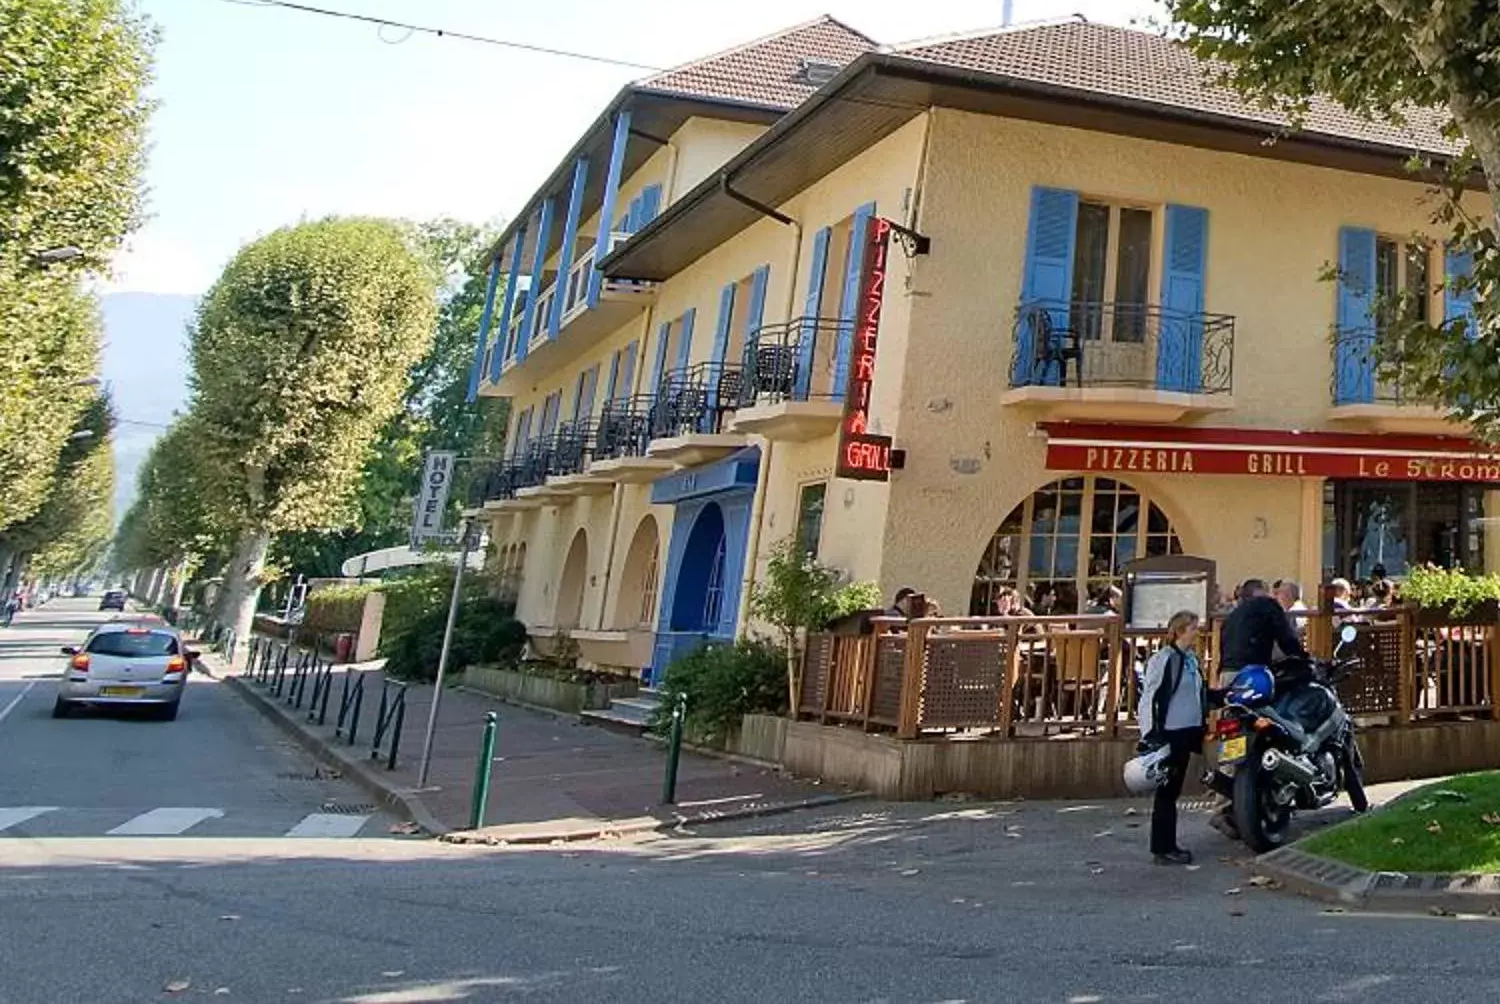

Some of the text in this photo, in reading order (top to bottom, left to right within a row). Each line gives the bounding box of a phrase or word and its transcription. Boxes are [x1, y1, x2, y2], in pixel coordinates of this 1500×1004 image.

[850, 218, 891, 434] PIZZERIA
[847, 442, 891, 471] GRILL
[1086, 447, 1194, 472] PIZZERIA
[1247, 452, 1307, 474] GRILL
[1359, 456, 1390, 478] Le
[423, 457, 447, 527] HOTEL
